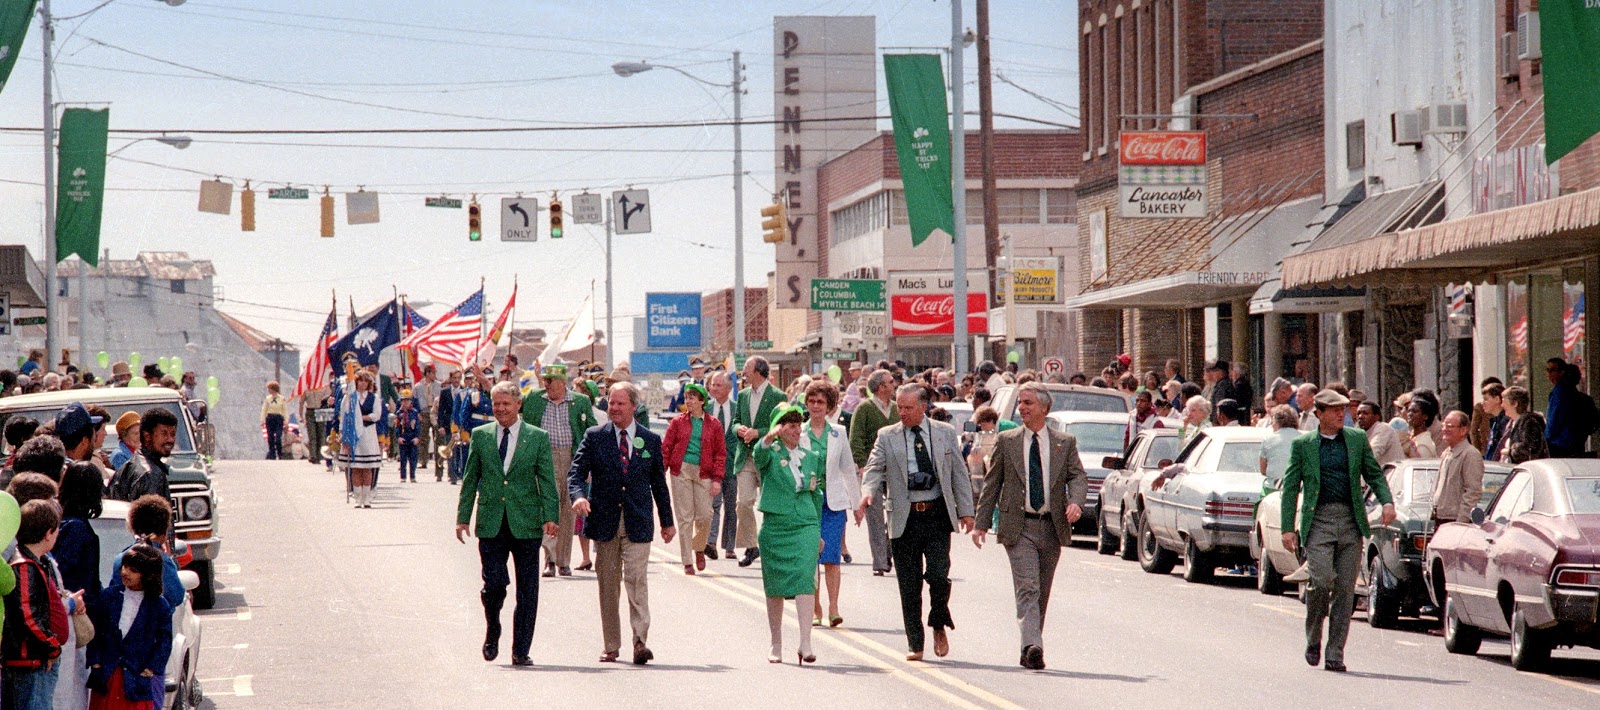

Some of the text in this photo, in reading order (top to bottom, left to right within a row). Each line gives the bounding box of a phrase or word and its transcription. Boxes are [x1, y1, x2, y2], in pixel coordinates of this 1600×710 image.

[1585, 0, 1600, 9] DA
[279, 190, 300, 199] ARCH
[1128, 187, 1203, 203] Lancaster
[1139, 202, 1186, 214] BAKERY
[507, 229, 532, 239] ONLY
[1012, 259, 1046, 269] AC'S
[1013, 271, 1054, 285] Biltmore
[1198, 271, 1239, 285] FRIENDLY
[820, 281, 850, 289] CAMDEN
[898, 278, 927, 289] Mac's
[819, 291, 857, 299] COLUMBIA
[650, 304, 678, 314] First
[819, 300, 848, 308] MYRTLE
[850, 301, 875, 309] BEACH
[650, 314, 698, 325] Citizens
[650, 326, 681, 337] Bank
[843, 324, 856, 333] 521
[865, 325, 884, 336] 200
